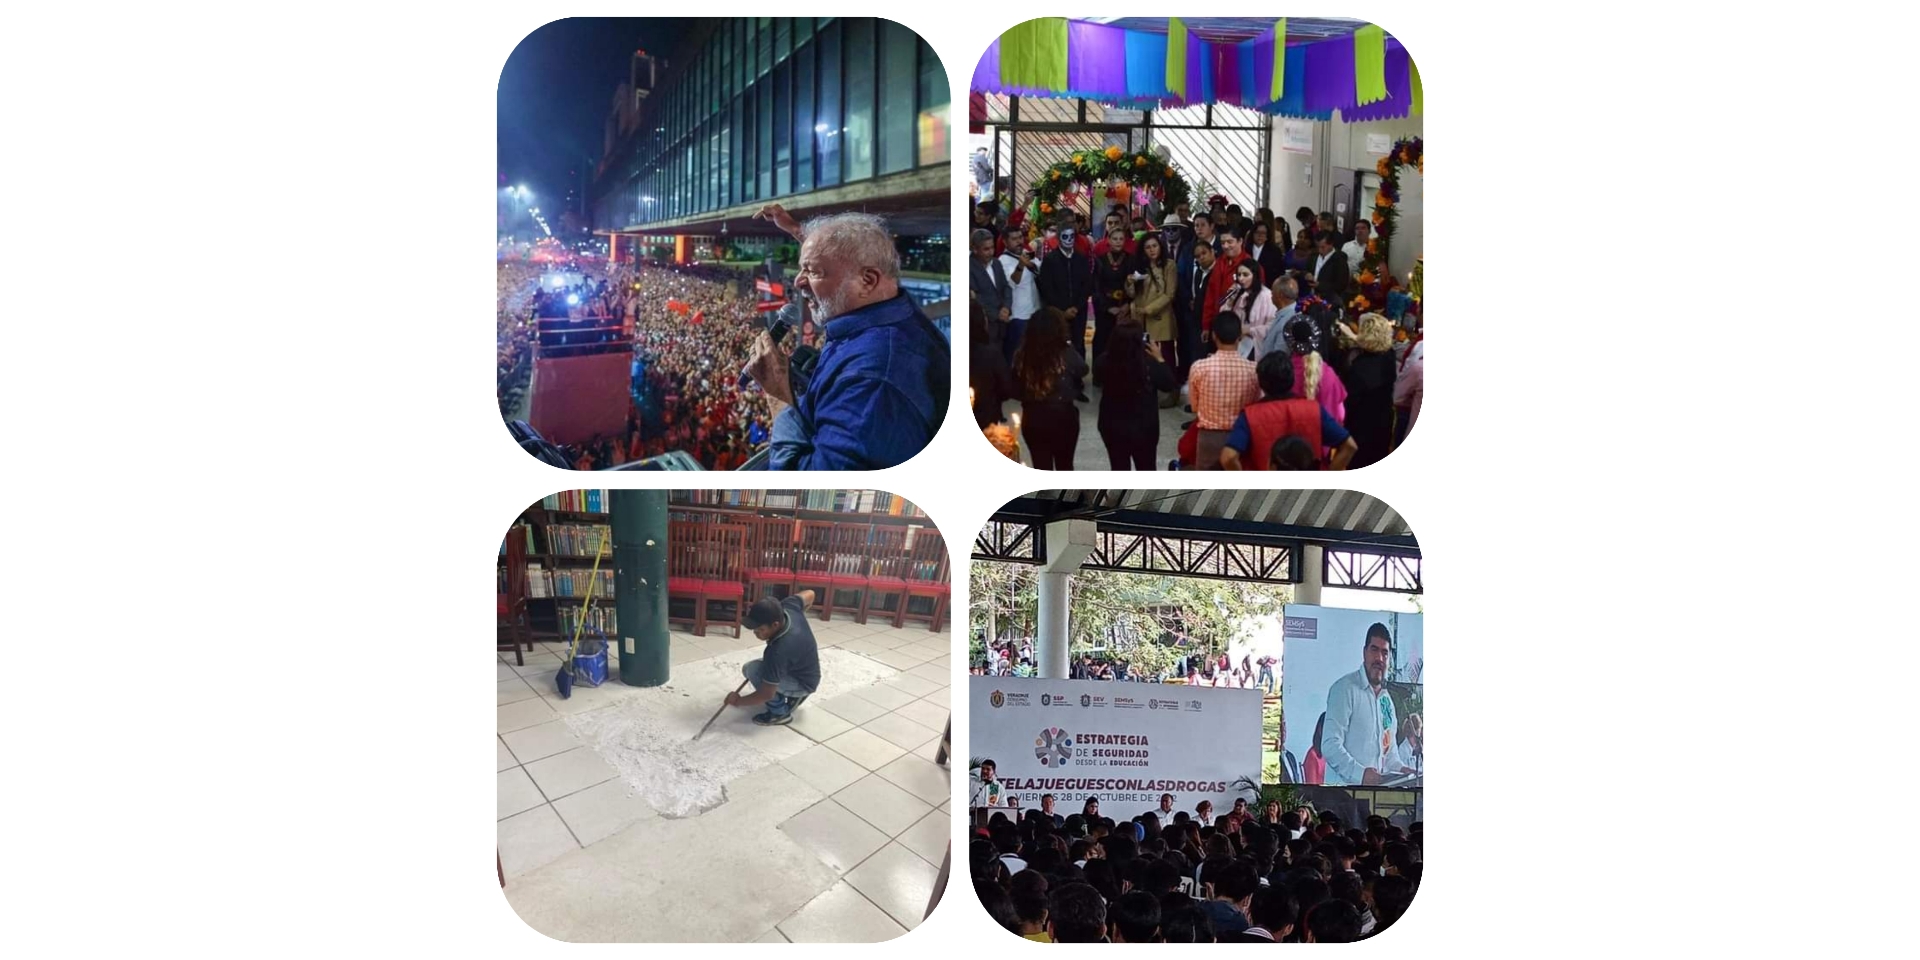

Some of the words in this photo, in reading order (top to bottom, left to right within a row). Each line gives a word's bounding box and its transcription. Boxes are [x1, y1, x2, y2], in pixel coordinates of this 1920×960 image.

[1076, 734, 1149, 746] ESTRATEGIA
[1076, 748, 1089, 757] DE
[1092, 748, 1149, 758] SEGURIDAD
[1061, 793, 1073, 801] 28
[1075, 793, 1089, 801] DE
[1092, 793, 1138, 802] OCTUBRE
[1140, 794, 1154, 802] DE
[1156, 794, 1178, 803] 22
